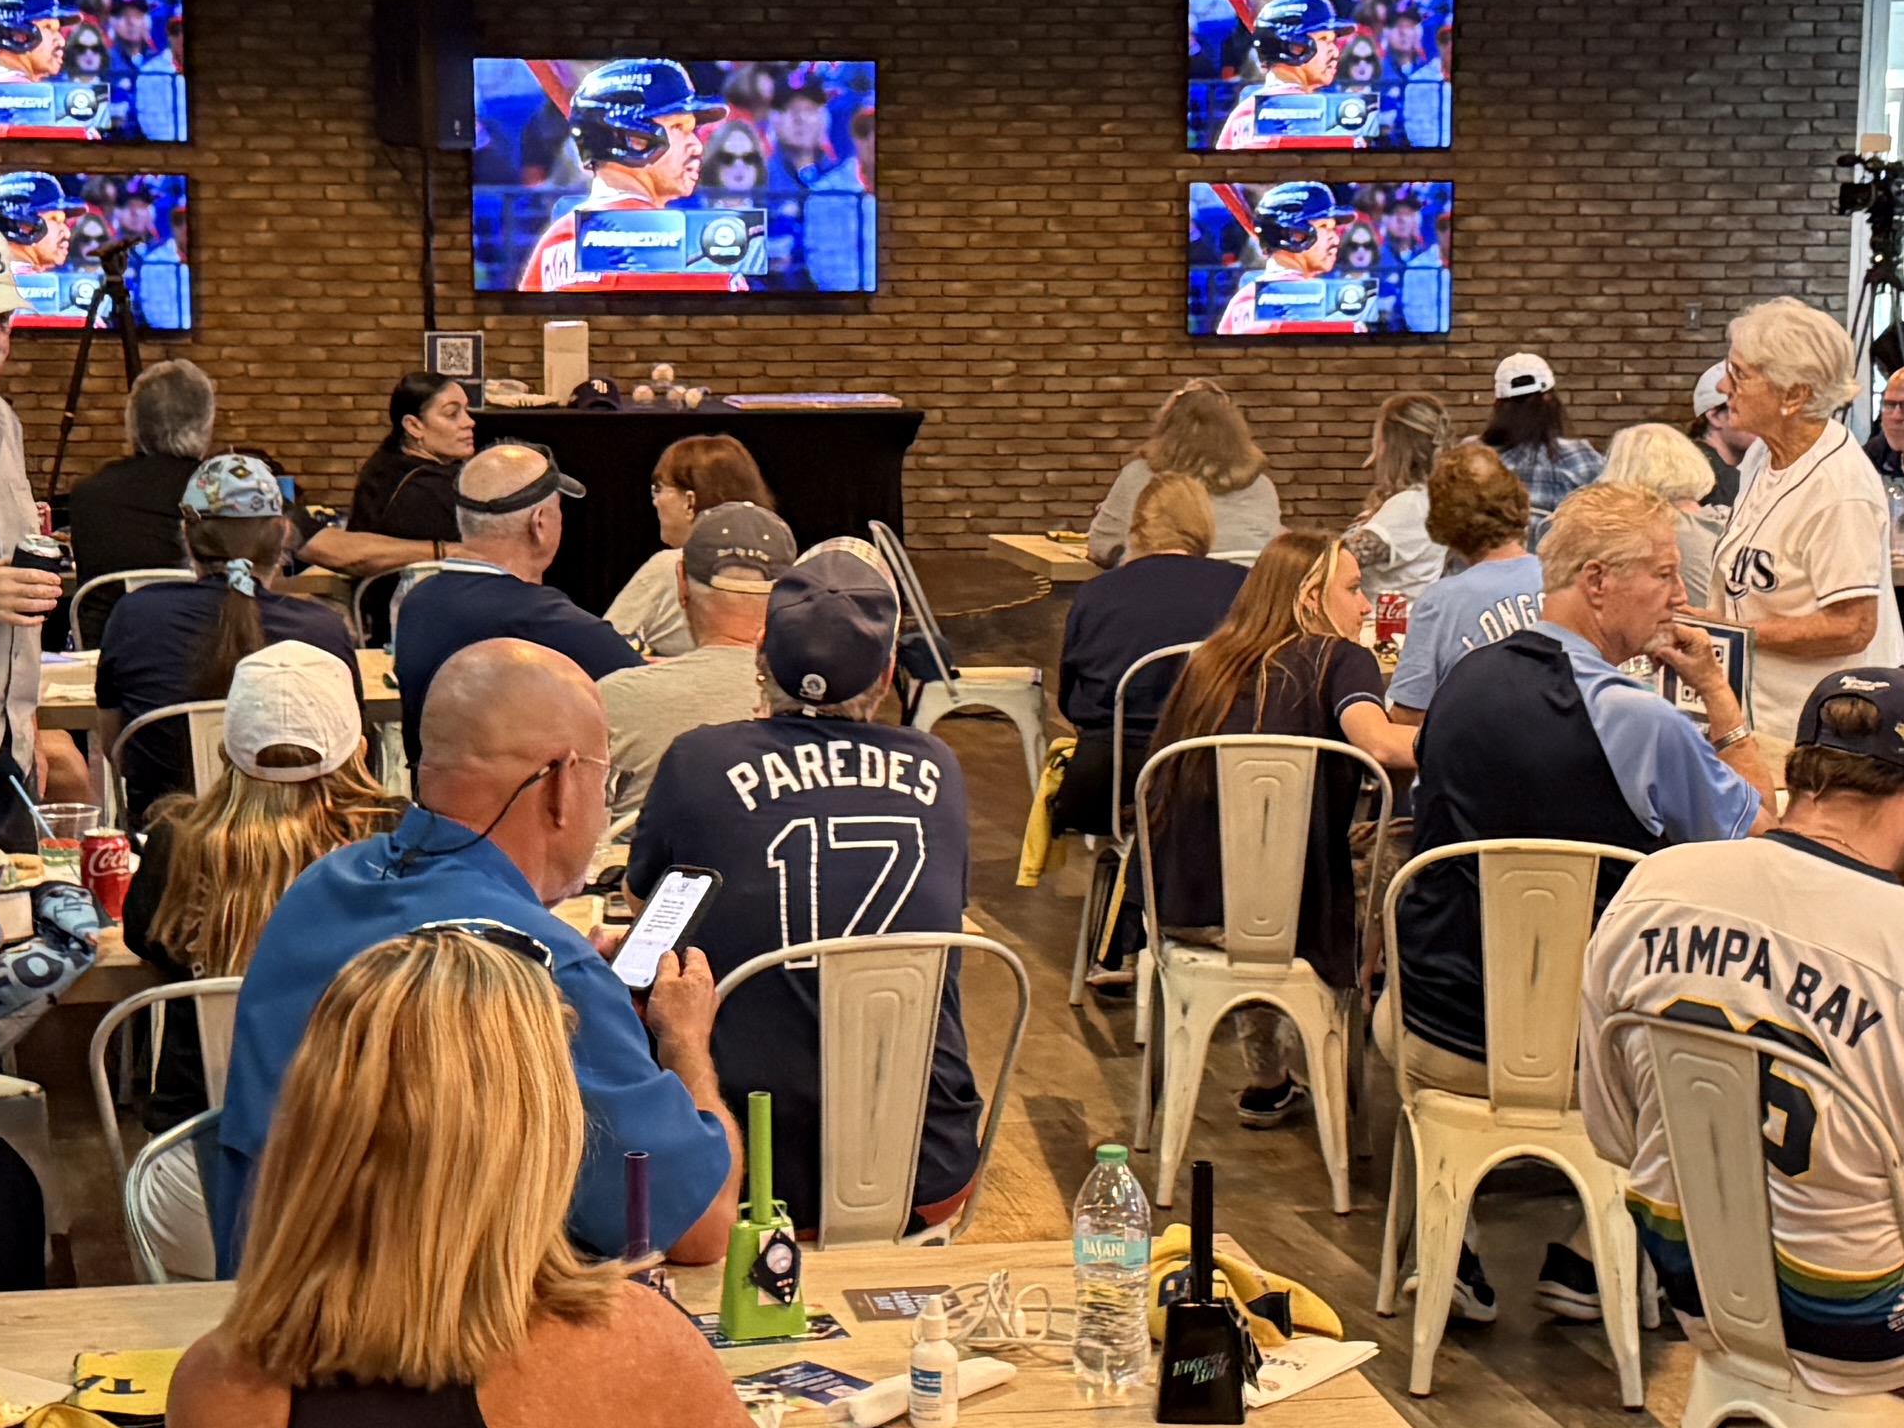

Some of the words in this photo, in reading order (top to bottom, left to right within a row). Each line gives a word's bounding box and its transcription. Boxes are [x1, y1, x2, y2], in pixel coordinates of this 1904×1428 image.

[725, 739, 941, 812] PAREDES
[766, 815, 926, 970] 17
[1638, 924, 1773, 991] TAMPA
[1785, 961, 1884, 1049] BAY
[1081, 1237, 1126, 1260] DASANI
